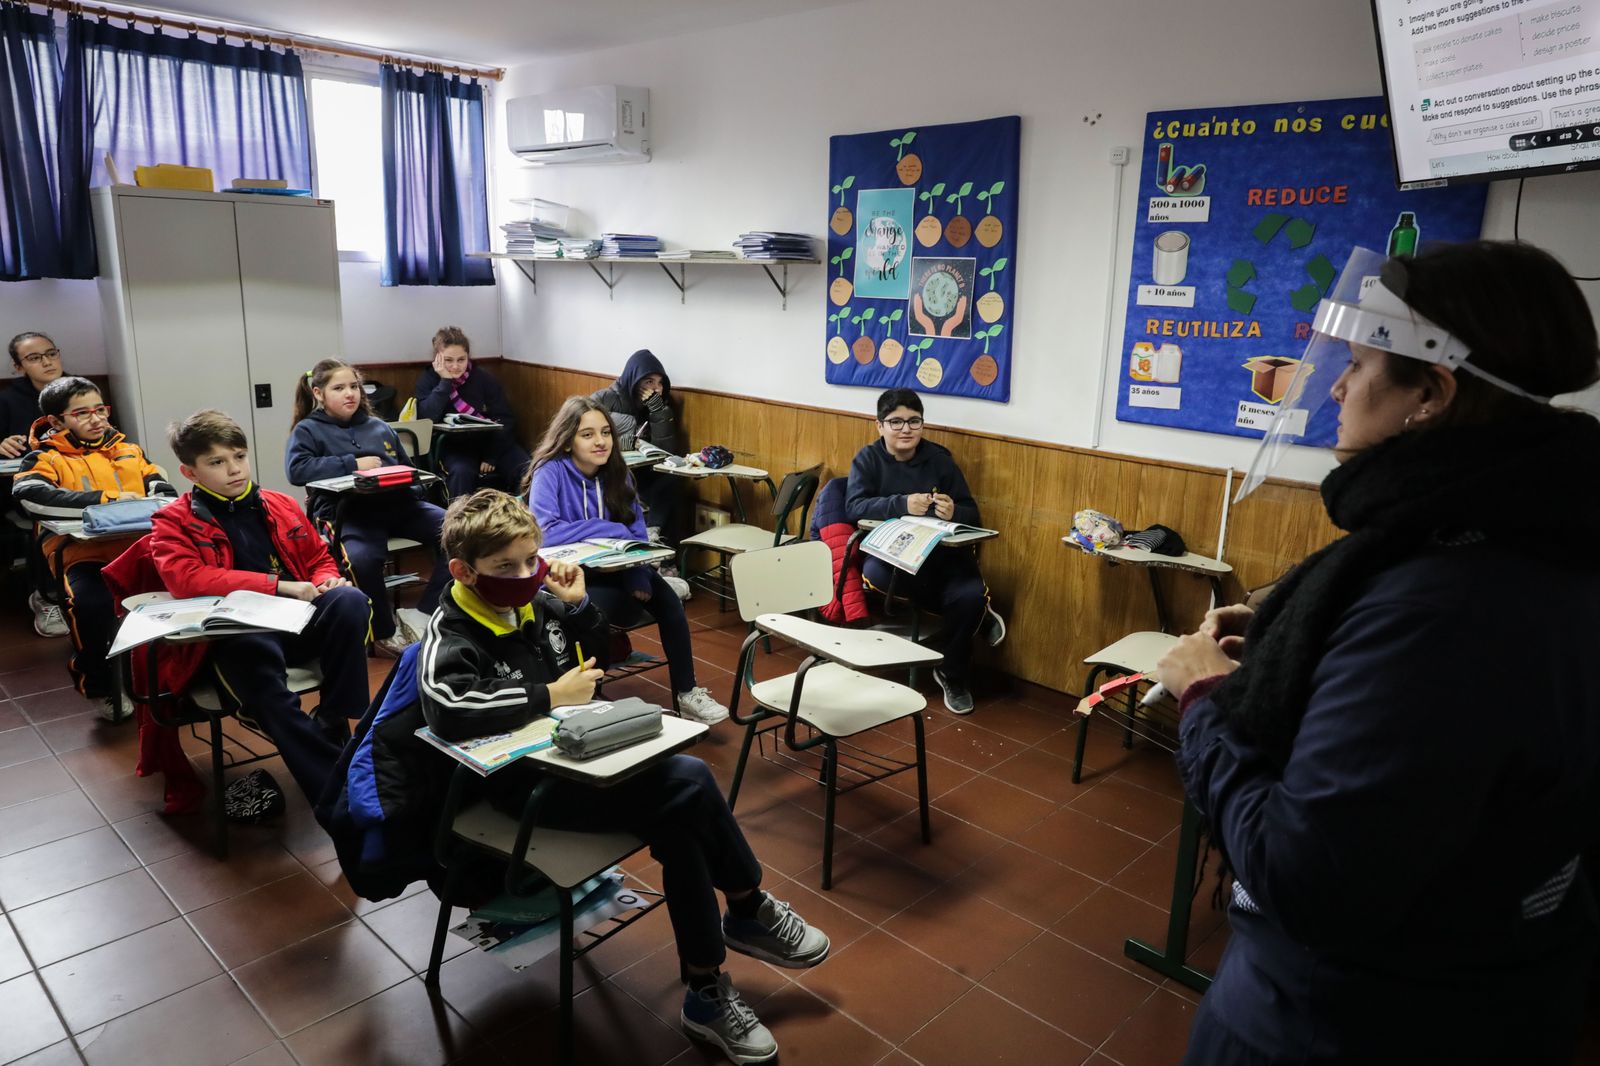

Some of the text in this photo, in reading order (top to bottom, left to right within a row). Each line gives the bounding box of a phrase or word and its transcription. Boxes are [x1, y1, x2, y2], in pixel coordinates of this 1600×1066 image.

[1398, 18, 1404, 27] 3
[1408, 10, 1435, 24] Imagine
[1436, 6, 1449, 17] you
[1450, 2, 1462, 11] are
[1411, 26, 1424, 36] Add
[1425, 23, 1437, 33] two
[1438, 17, 1455, 28] more
[1456, 3, 1501, 23] suggestions
[1502, 1, 1510, 9] to
[1530, 14, 1550, 24] make
[1433, 39, 1452, 50] people
[1460, 31, 1483, 43] donate
[1484, 27, 1503, 38] cakes
[1532, 22, 1581, 40] decide prices
[1533, 44, 1557, 57] design
[1564, 36, 1592, 50] poster
[1410, 104, 1415, 112] 4
[1434, 99, 1445, 108] Act
[1445, 96, 1457, 105] out
[1464, 86, 1510, 102] conversation
[1511, 80, 1535, 92] about
[1535, 75, 1564, 87] setting
[1565, 72, 1577, 82] up
[1578, 68, 1593, 79] the
[1422, 113, 1439, 122] Make
[1440, 110, 1453, 119] and
[1453, 105, 1482, 117] respond
[1491, 93, 1540, 110] suggestions.
[1541, 91, 1557, 100] Use
[1558, 87, 1572, 97] the
[1553, 109, 1576, 119] That's
[1274, 115, 1323, 133] nos
[1433, 133, 1447, 141] Why
[1447, 128, 1462, 138] don't
[1472, 124, 1498, 136] organise
[1505, 120, 1520, 129] cake
[1521, 116, 1538, 127] sale?
[1431, 161, 1445, 169] Let's
[1486, 153, 1500, 161] How
[1150, 198, 1206, 209] 500 a 1000
[1247, 185, 1349, 206] REDUCE
[1149, 213, 1170, 222] años
[1154, 288, 1166, 296] 10
[1166, 287, 1187, 298] años
[1145, 318, 1262, 338] REUTILIZA
[1131, 387, 1160, 396] 35 años
[1240, 403, 1247, 412] 6
[1248, 406, 1276, 416] meses
[1237, 416, 1255, 425] año
